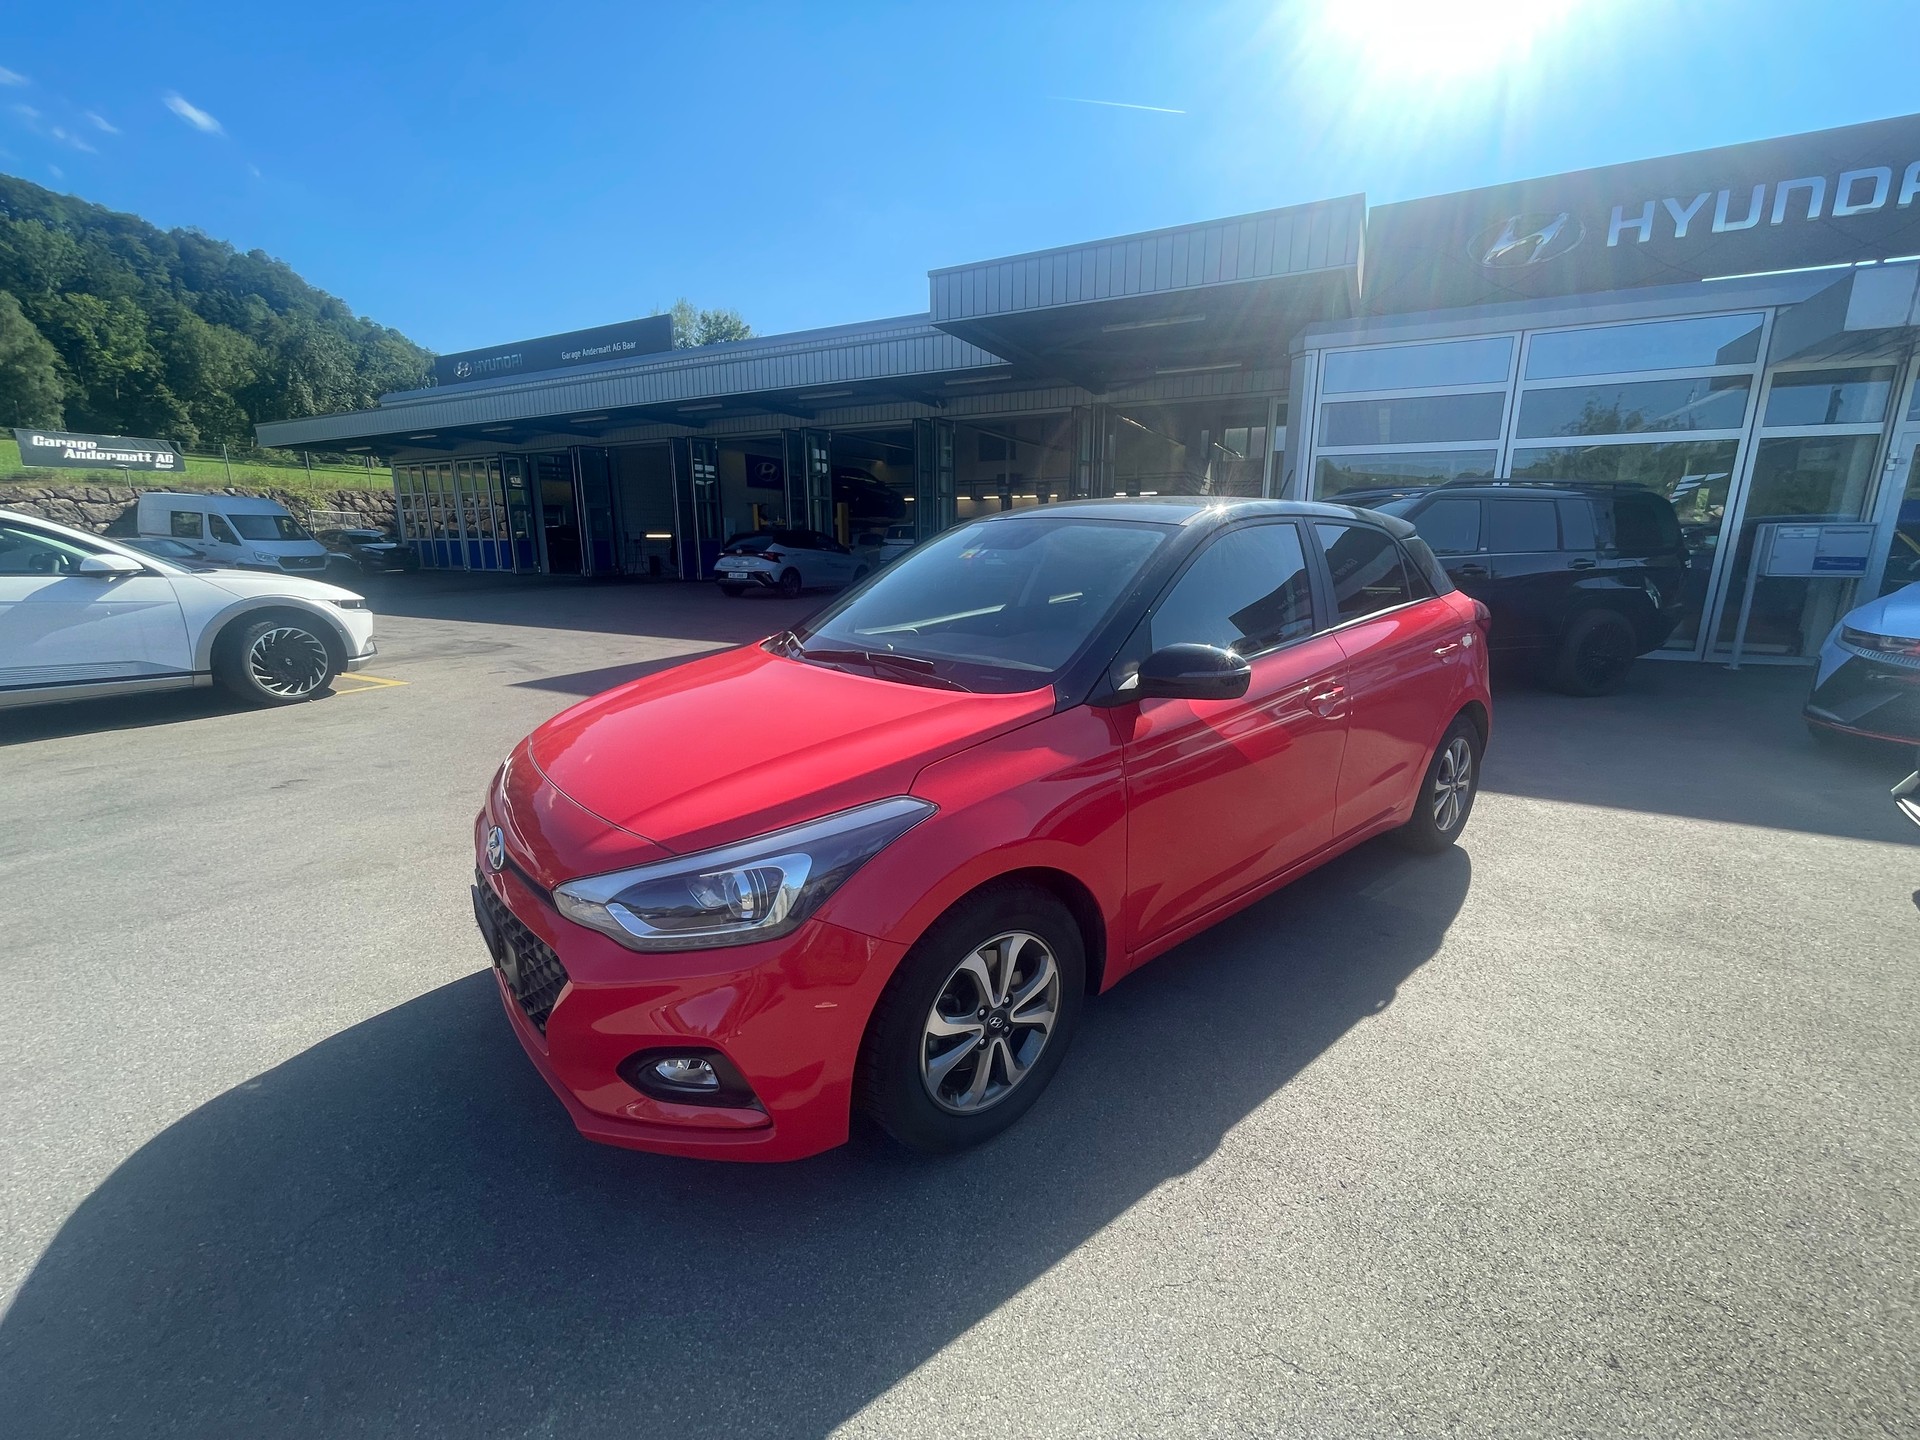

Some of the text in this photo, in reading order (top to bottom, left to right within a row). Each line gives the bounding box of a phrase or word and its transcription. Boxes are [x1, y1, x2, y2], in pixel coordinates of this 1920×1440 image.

[561, 341, 637, 361] Garage Andermatt AG Baar
[473, 353, 523, 374] HYUNDAI
[31, 435, 98, 450] Garage
[64, 448, 174, 464] Andermatt AG
